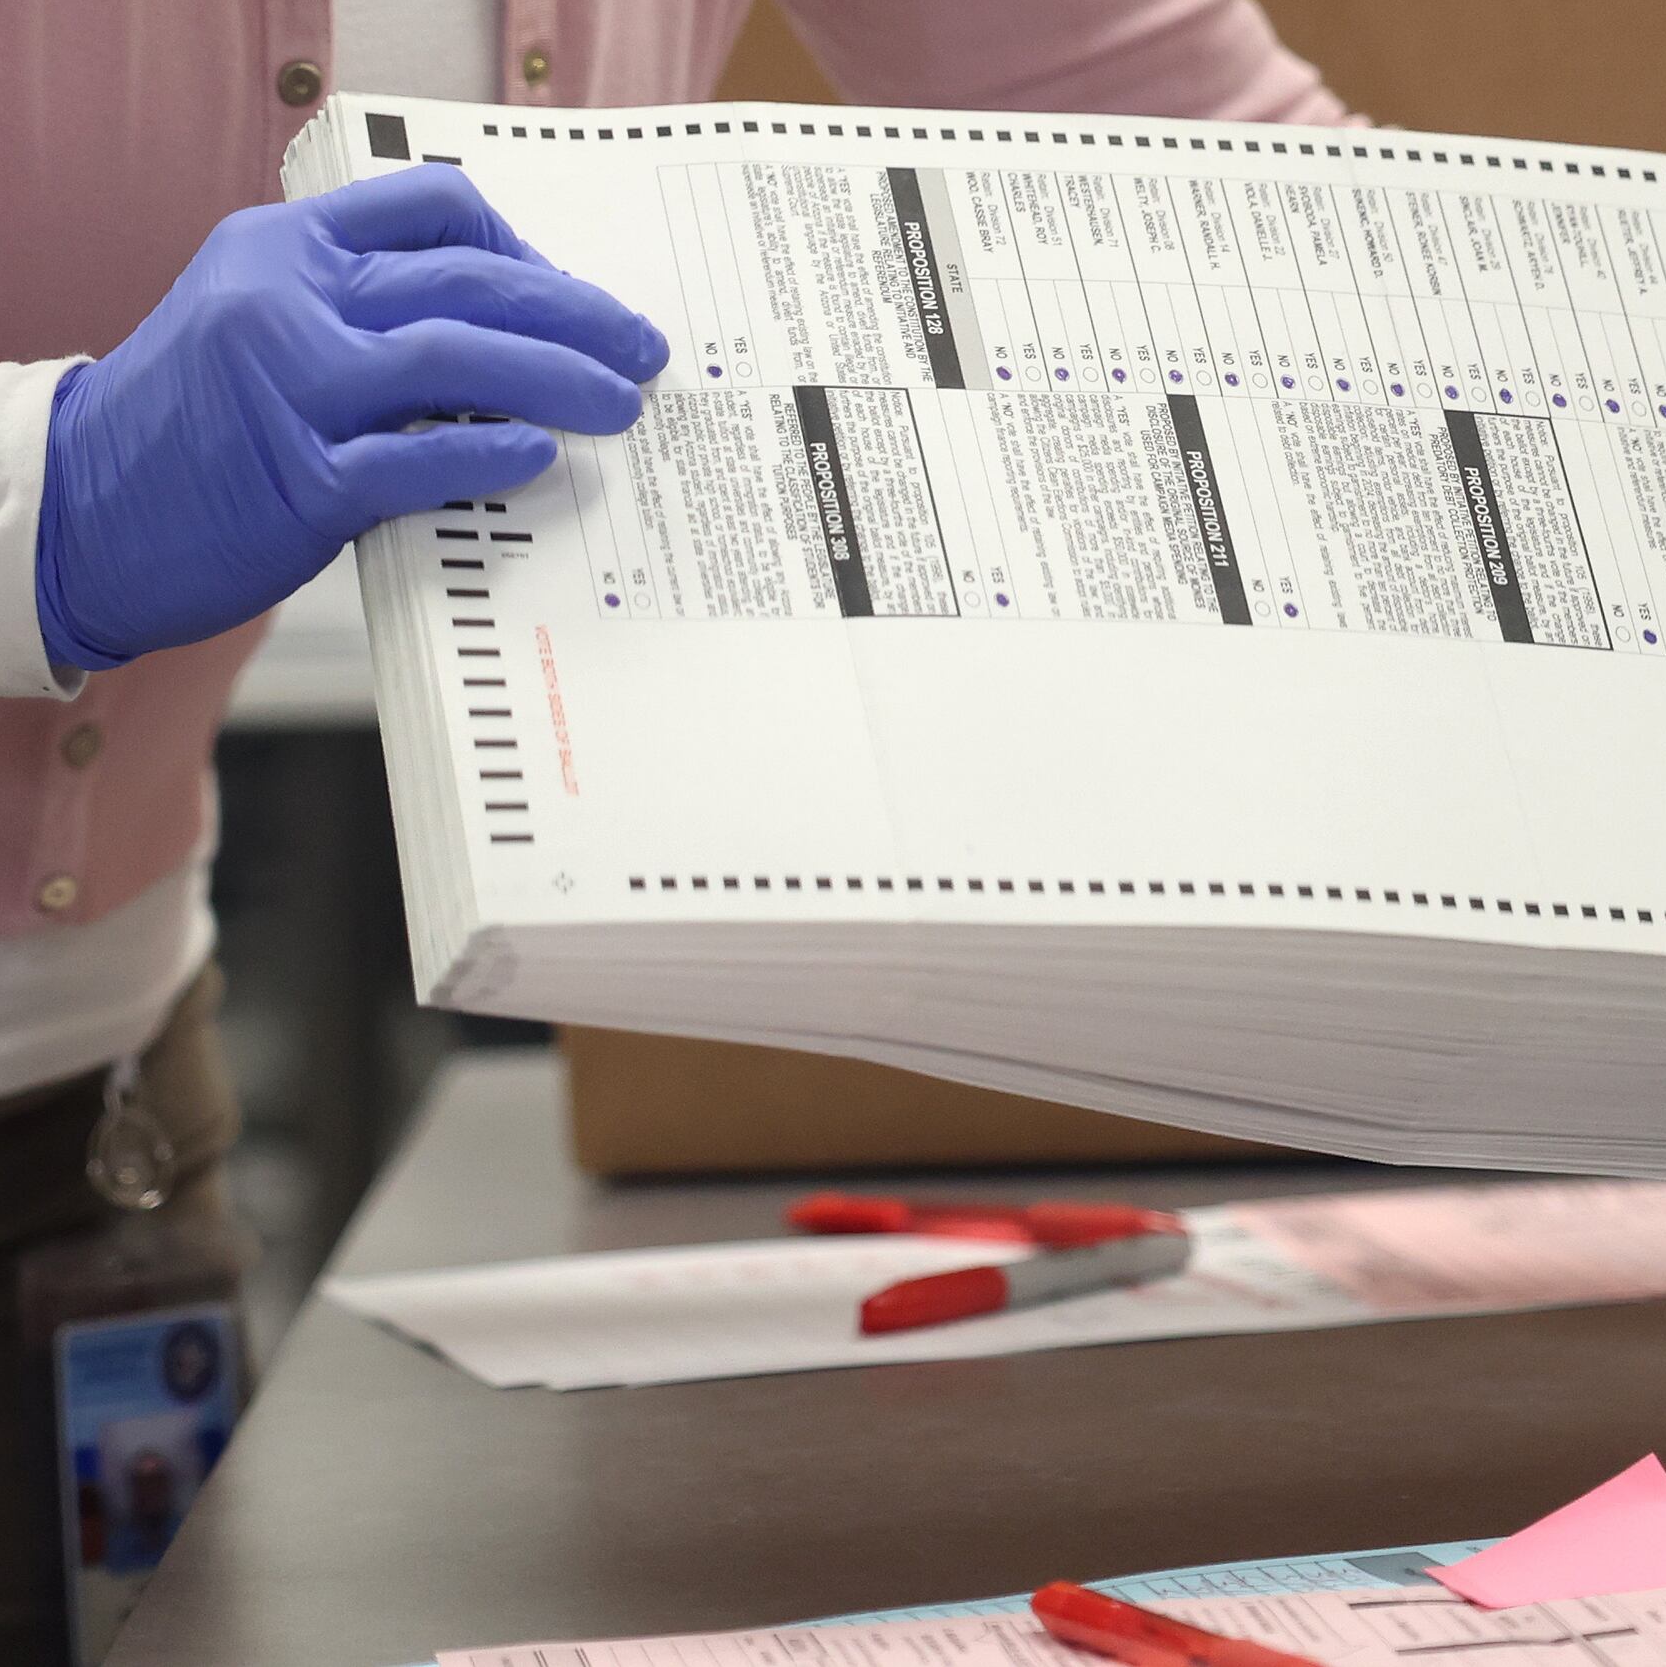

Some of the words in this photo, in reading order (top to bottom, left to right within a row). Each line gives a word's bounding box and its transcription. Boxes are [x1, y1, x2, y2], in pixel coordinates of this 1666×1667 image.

[878, 171, 894, 214] PROPOSED
[1007, 172, 1026, 213] CHARLES
[1065, 174, 1080, 208] TRACEY
[1285, 184, 1299, 213] HEARN
[869, 193, 891, 246] LEGISLATURE
[971, 196, 988, 227] CASSIE
[1035, 226, 1048, 245] ROY
[1141, 209, 1158, 243] JOSEPH
[1251, 210, 1271, 252] DANIELLE
[886, 215, 906, 264] AMENDMENT
[978, 229, 993, 253] BRAY
[1200, 220, 1217, 259] RANDALL
[1311, 230, 1327, 266] PAMELA
[1364, 229, 1381, 268] HOWARD
[872, 249, 892, 304] REFERENDUM
[882, 248, 900, 287] RELATING
[897, 266, 909, 277] TO
[905, 221, 937, 309] PROPOSITION
[925, 313, 944, 334] 128
[946, 263, 963, 293] STATE
[891, 289, 903, 300] TO
[900, 278, 913, 294] THE
[894, 301, 912, 340] INITIATIVE
[904, 295, 925, 353] CONSTITUTION
[704, 341, 718, 355] NO
[733, 336, 748, 354] YES
[903, 341, 917, 359] AND
[994, 345, 1008, 359] NO
[1023, 342, 1037, 359] YES
[1052, 346, 1065, 360] NO
[1079, 343, 1094, 360] YES
[1108, 347, 1122, 361] NO
[1136, 344, 1151, 361] YES
[1165, 349, 1179, 363] NO
[1193, 346, 1207, 364] YES
[916, 353, 929, 365] BY
[1221, 352, 1235, 366] NO
[1249, 349, 1263, 366] YES
[1277, 354, 1291, 368] NO
[1305, 352, 1319, 369] YES
[921, 366, 933, 382] THE
[769, 393, 787, 434] RELATING
[783, 402, 802, 446] REFERRED
[1157, 402, 1178, 447] PROPOSED
[778, 435, 790, 447] TO
[1140, 429, 1155, 452] USED
[1146, 405, 1168, 456] DISCLOSURE
[781, 448, 794, 465] THE
[793, 447, 805, 459] TO
[1167, 447, 1182, 459] BY
[1429, 433, 1449, 483] PREDATORY
[1438, 426, 1459, 471] PROPOSED
[796, 460, 809, 476] THE
[1146, 452, 1160, 470] FOR
[1158, 457, 1171, 469] OF
[772, 463, 787, 495] TUITION
[1162, 470, 1176, 486] THE
[1171, 460, 1191, 501] INITIATIVE
[1448, 472, 1463, 485] BY
[784, 466, 807, 532] CLASSIFICATION
[800, 478, 816, 510] PEOPLE
[811, 442, 843, 534] PROPOSITION
[830, 536, 850, 560] 308
[1150, 471, 1169, 514] CAMPAIGN
[1441, 484, 1457, 507] DEBT
[806, 511, 818, 523] BY
[1166, 487, 1183, 526] ORIGINAL
[1188, 450, 1222, 541] PROPOSITION
[1209, 543, 1229, 566] 211
[1453, 485, 1472, 526] INITIATIVE
[779, 496, 798, 540] PURPOSES
[1162, 516, 1176, 541] MEDIA
[1183, 502, 1199, 539] PETITION
[1465, 467, 1500, 559] PROPOSITION
[1488, 561, 1508, 585] 209
[799, 533, 812, 545] OF
[811, 524, 823, 541] THE
[1448, 508, 1469, 560] COLLECTION
[1176, 528, 1194, 562] SOURCE
[1464, 528, 1481, 565] PETITION
[802, 546, 821, 589] STUDENTS
[813, 543, 835, 599] LEGISLATURE
[1168, 543, 1188, 584] SPENDING
[1185, 563, 1198, 575] OF
[1192, 541, 1211, 581] RELATING
[603, 572, 616, 585] NO
[632, 568, 646, 585] YES
[962, 569, 975, 582] NO
[1252, 579, 1265, 592] NO
[1279, 576, 1294, 594] YES
[1463, 561, 1483, 614] PROTECTION
[1475, 566, 1493, 608] RELATING
[812, 591, 825, 608] FOR
[1189, 577, 1206, 608] MONIES
[1203, 583, 1214, 595] TO
[1207, 596, 1219, 613] THE
[1486, 609, 1497, 621] TO
[1612, 604, 1625, 618] NO
[1638, 602, 1652, 621] YES
